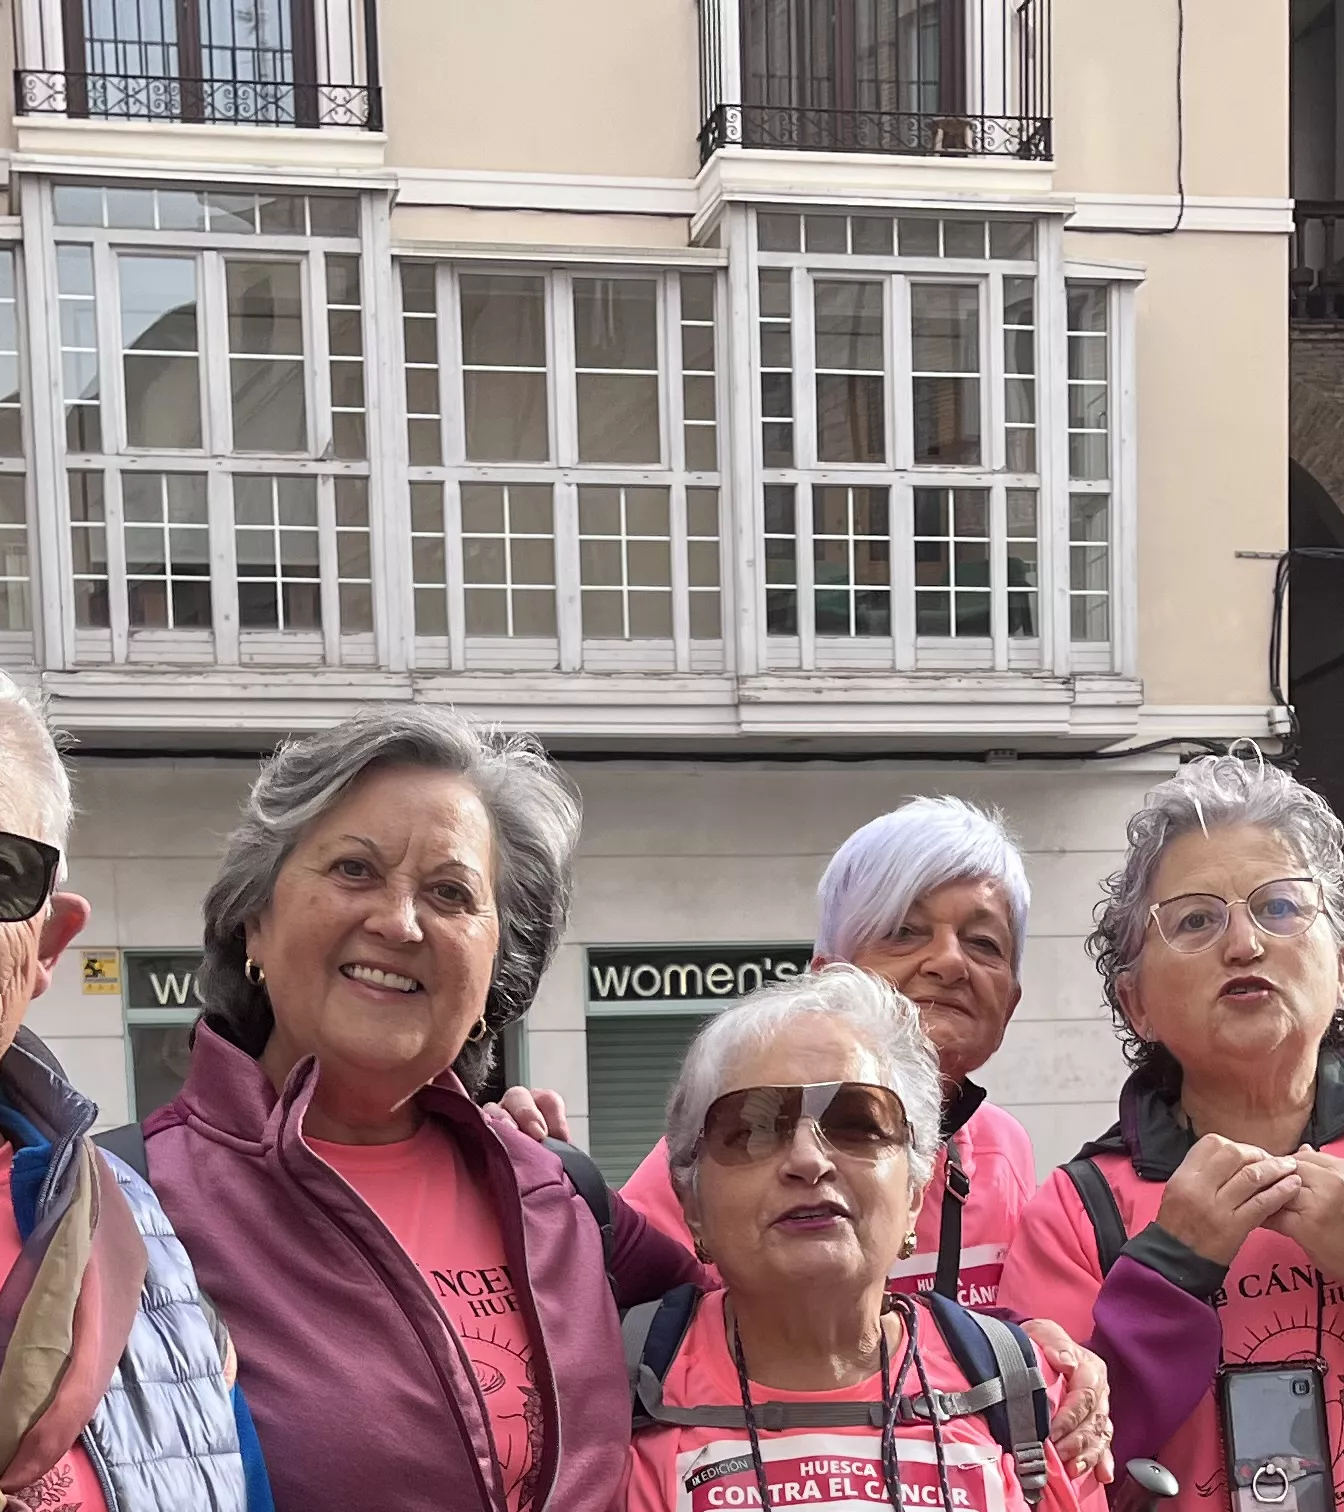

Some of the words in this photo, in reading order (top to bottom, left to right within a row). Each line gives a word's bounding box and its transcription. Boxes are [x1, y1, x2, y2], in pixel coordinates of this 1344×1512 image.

[700, 1459, 749, 1482] EDICIÓN
[800, 1460, 877, 1478] HUESCA
[707, 1481, 822, 1506] CONTRA
[828, 1477, 857, 1498] EL
